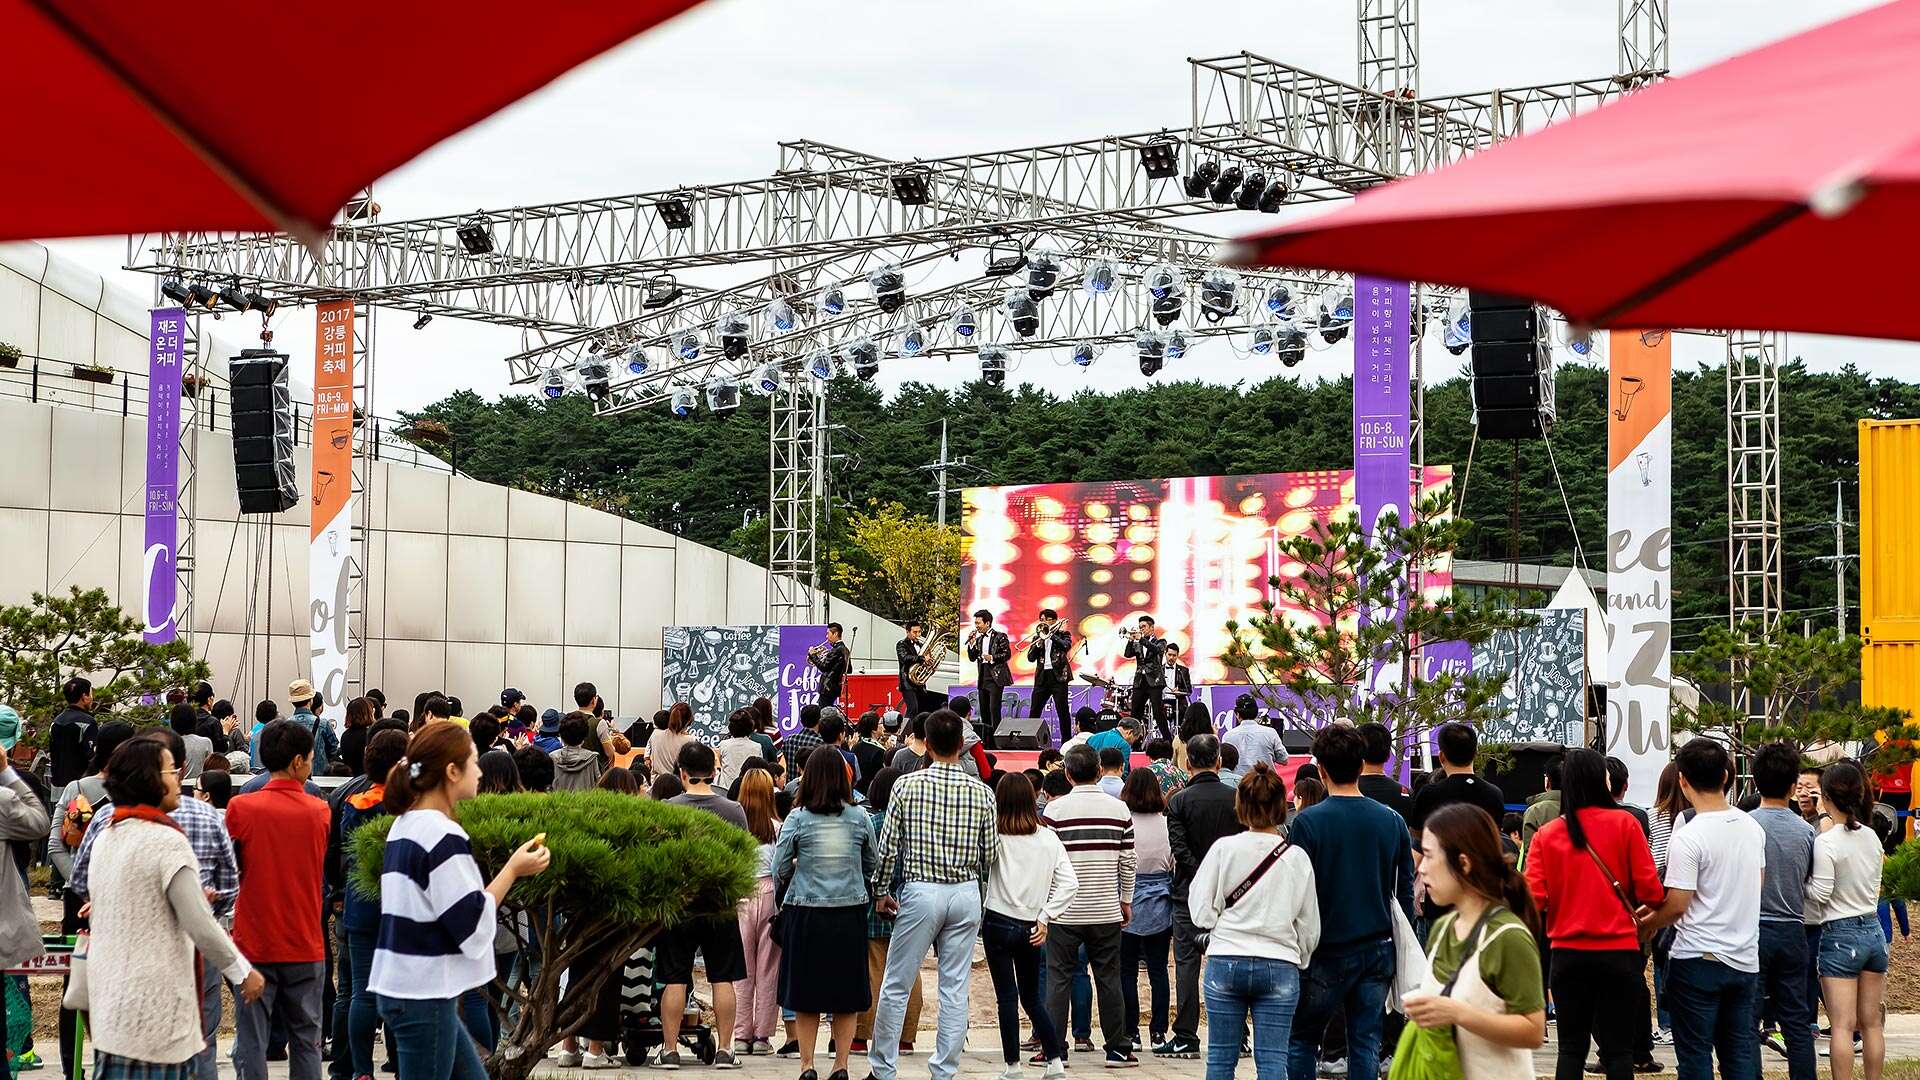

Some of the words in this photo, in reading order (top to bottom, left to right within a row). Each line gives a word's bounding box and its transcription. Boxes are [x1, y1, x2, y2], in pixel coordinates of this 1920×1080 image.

[1371, 286, 1380, 318] 음악이
[321, 309, 350, 323] 2017
[157, 319, 178, 335] 재즈
[324, 325, 346, 341] 강릉
[324, 342, 346, 357] 커피
[1383, 336, 1393, 356] 재즈
[156, 352, 176, 367] 커피
[323, 359, 346, 374] 축제
[1371, 363, 1380, 384] 거리
[1383, 363, 1393, 394] 그리고
[318, 392, 344, 403] 10.6-9.
[1360, 422, 1395, 435] 10.6-8.
[1359, 436, 1404, 449] FRI-SUN
[1609, 580, 1668, 611] and
